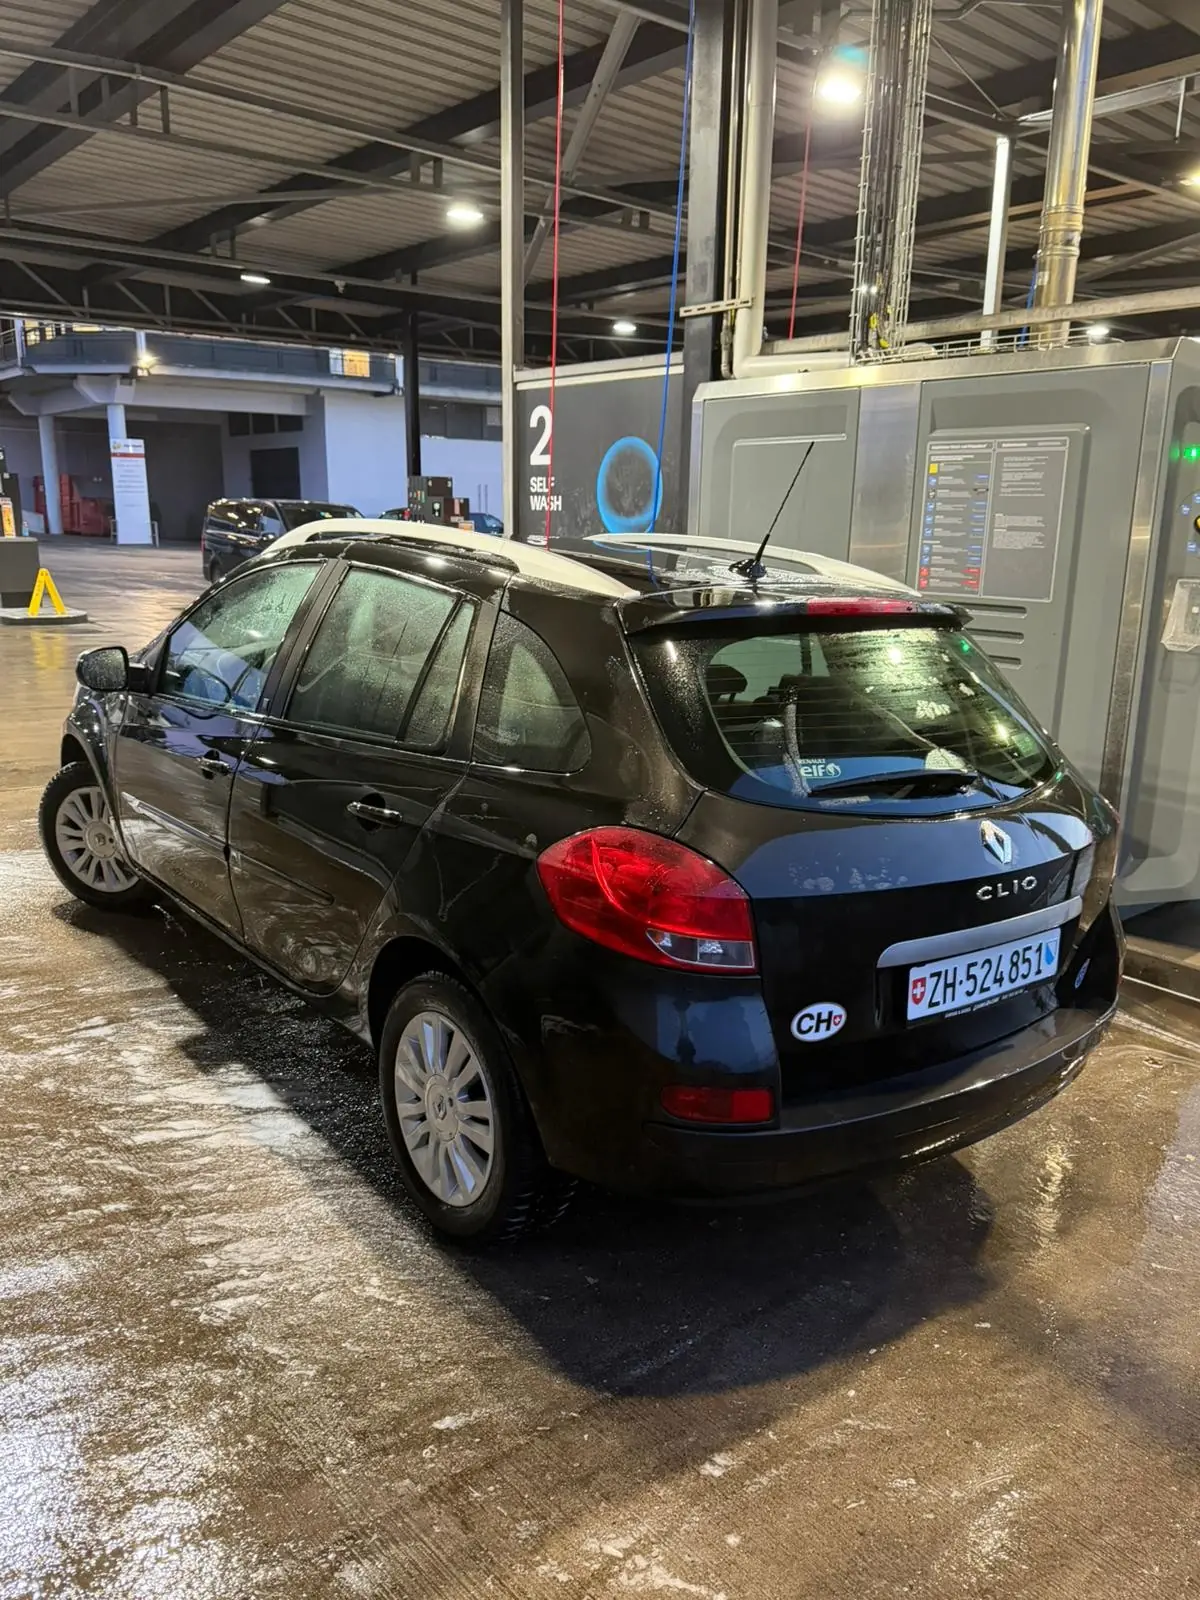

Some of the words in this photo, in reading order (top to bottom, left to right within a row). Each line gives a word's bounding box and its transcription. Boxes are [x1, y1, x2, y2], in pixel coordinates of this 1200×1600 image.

[530, 405, 553, 466] 2
[530, 495, 562, 512] WASH
[800, 764, 826, 777] elf
[976, 875, 1038, 901] CLIO
[796, 1010, 833, 1035] CH
